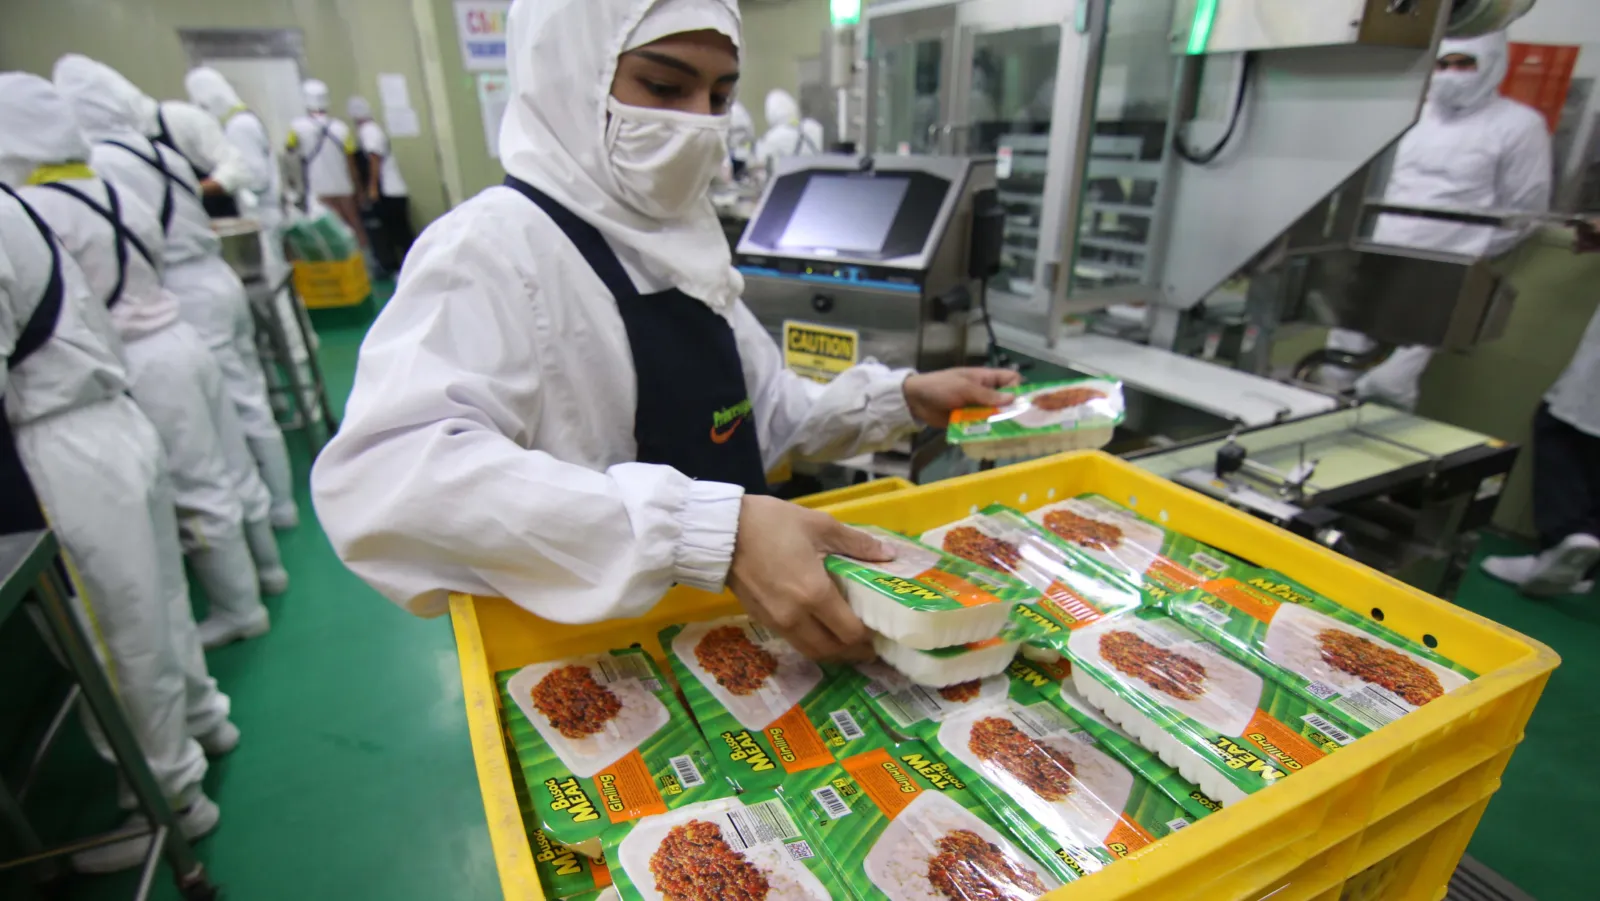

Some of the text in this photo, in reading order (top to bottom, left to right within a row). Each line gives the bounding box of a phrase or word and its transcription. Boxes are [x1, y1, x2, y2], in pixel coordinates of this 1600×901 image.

[790, 330, 853, 359] CAUTION
[1016, 604, 1062, 633] MEAL
[735, 730, 775, 772] MEAL
[1218, 737, 1288, 780] MEAL
[1248, 733, 1303, 770] Giniling
[901, 753, 950, 790] MEAL
[559, 777, 600, 823] MEAL
[599, 774, 625, 812] Giniling
[550, 841, 582, 876] ME
[1057, 851, 1087, 876] USOG
